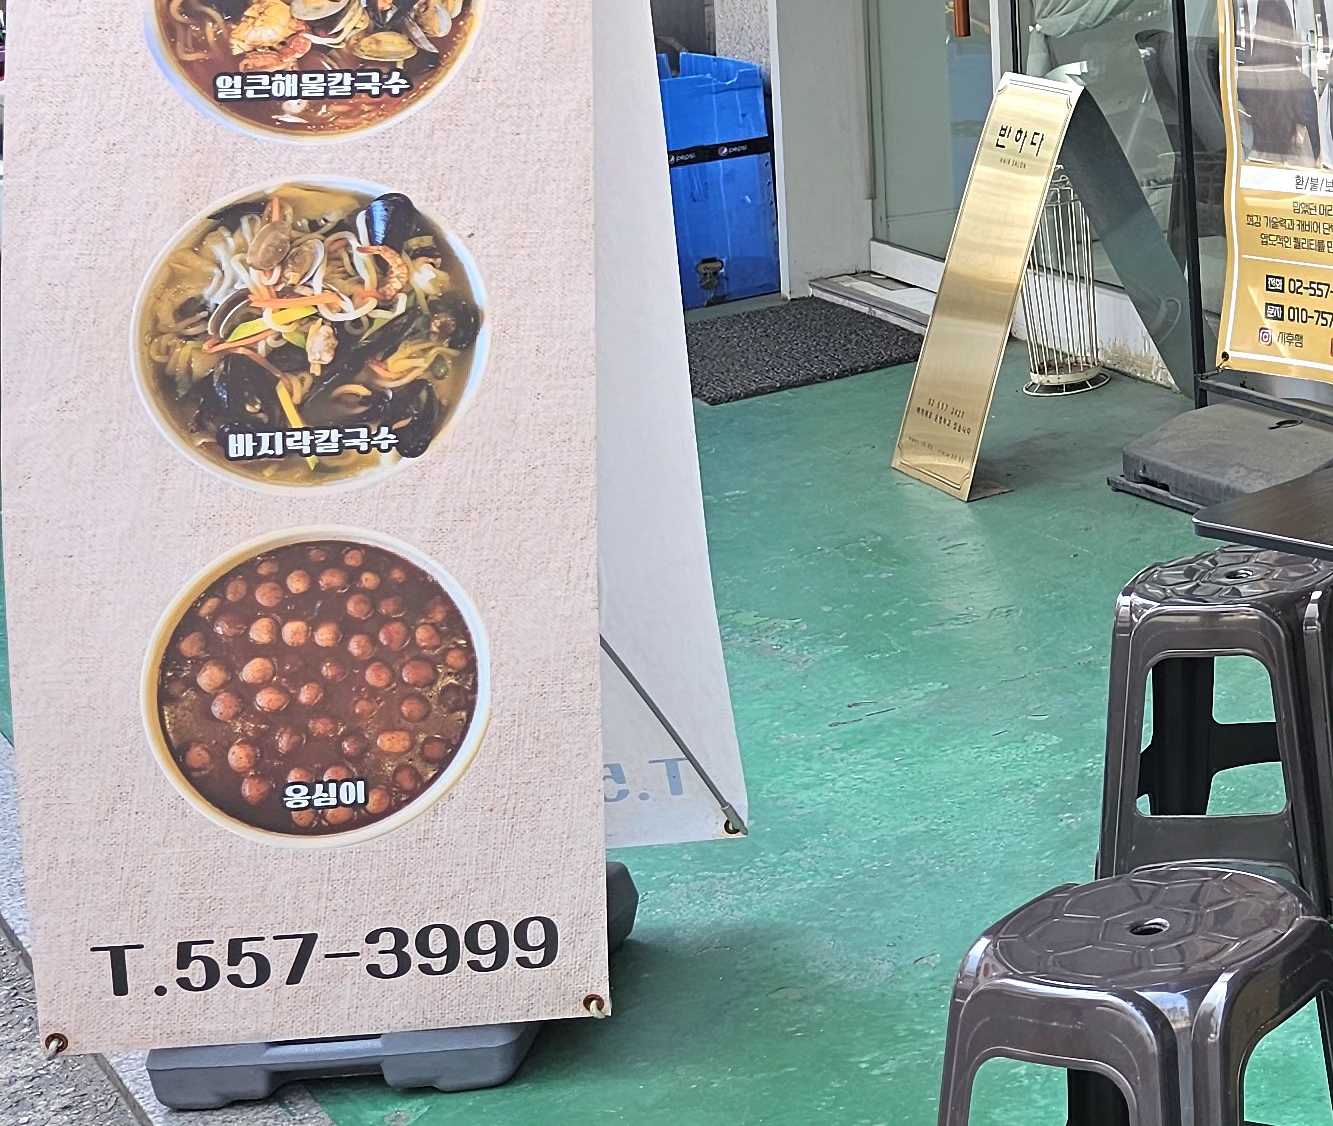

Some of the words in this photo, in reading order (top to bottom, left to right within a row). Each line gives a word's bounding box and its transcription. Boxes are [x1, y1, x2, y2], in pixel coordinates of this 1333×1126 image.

[215, 71, 412, 100] 얼큰해물칼국수
[995, 124, 1045, 157] 반하다
[228, 426, 400, 459] 바지락칼국수
[283, 779, 367, 810] 옹심이
[90, 915, 560, 998] T.557-3999
